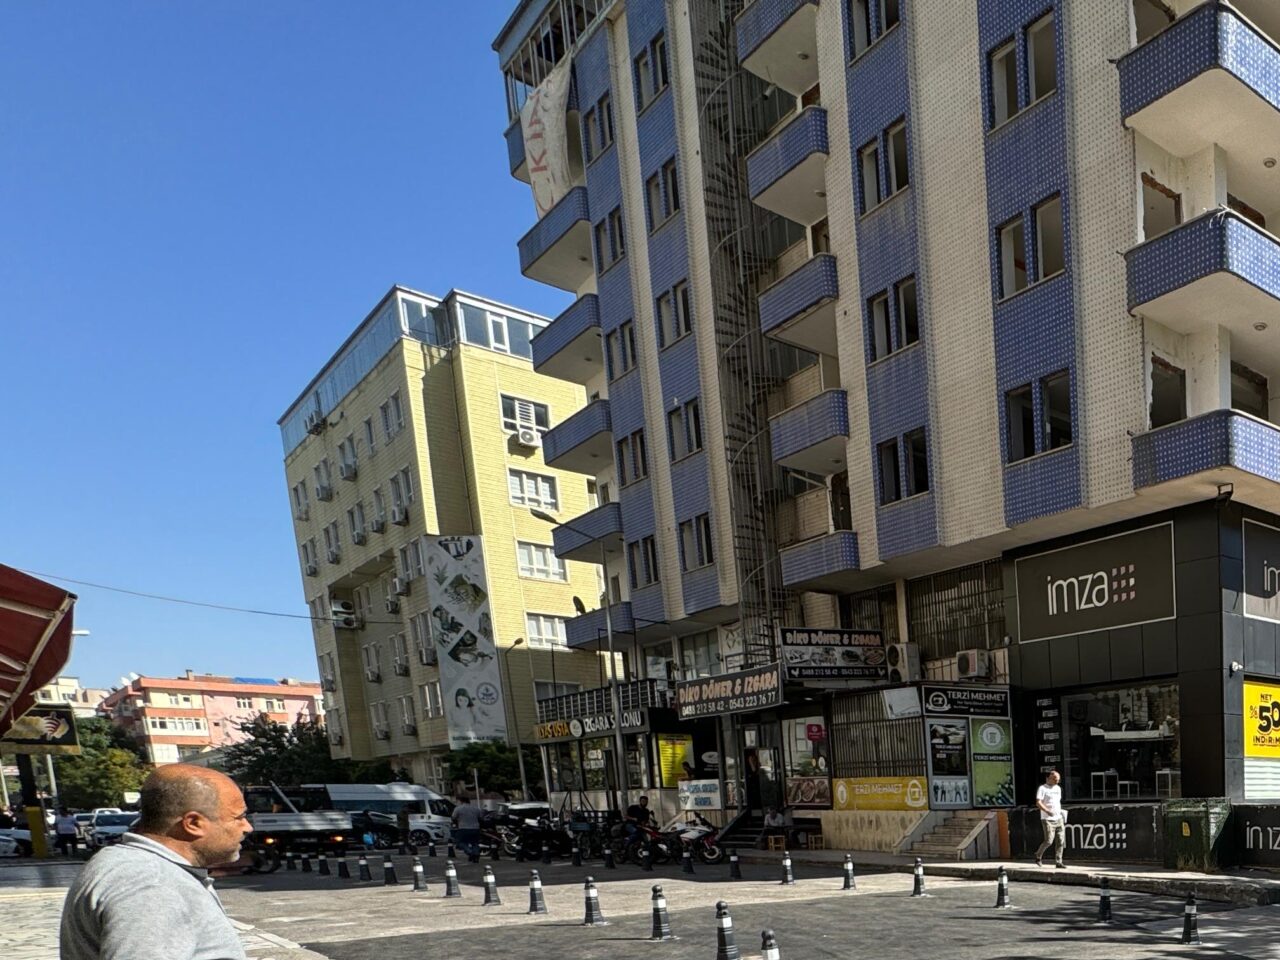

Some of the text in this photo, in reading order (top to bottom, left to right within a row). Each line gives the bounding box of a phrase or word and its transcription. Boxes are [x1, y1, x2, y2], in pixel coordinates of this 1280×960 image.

[1047, 571, 1108, 615] imza
[744, 671, 778, 693] IZGARA
[971, 692, 1006, 701] MEHMET
[1260, 693, 1273, 701] NET
[583, 711, 641, 733] IZGARA SLONU
[1063, 823, 1107, 850] mza
